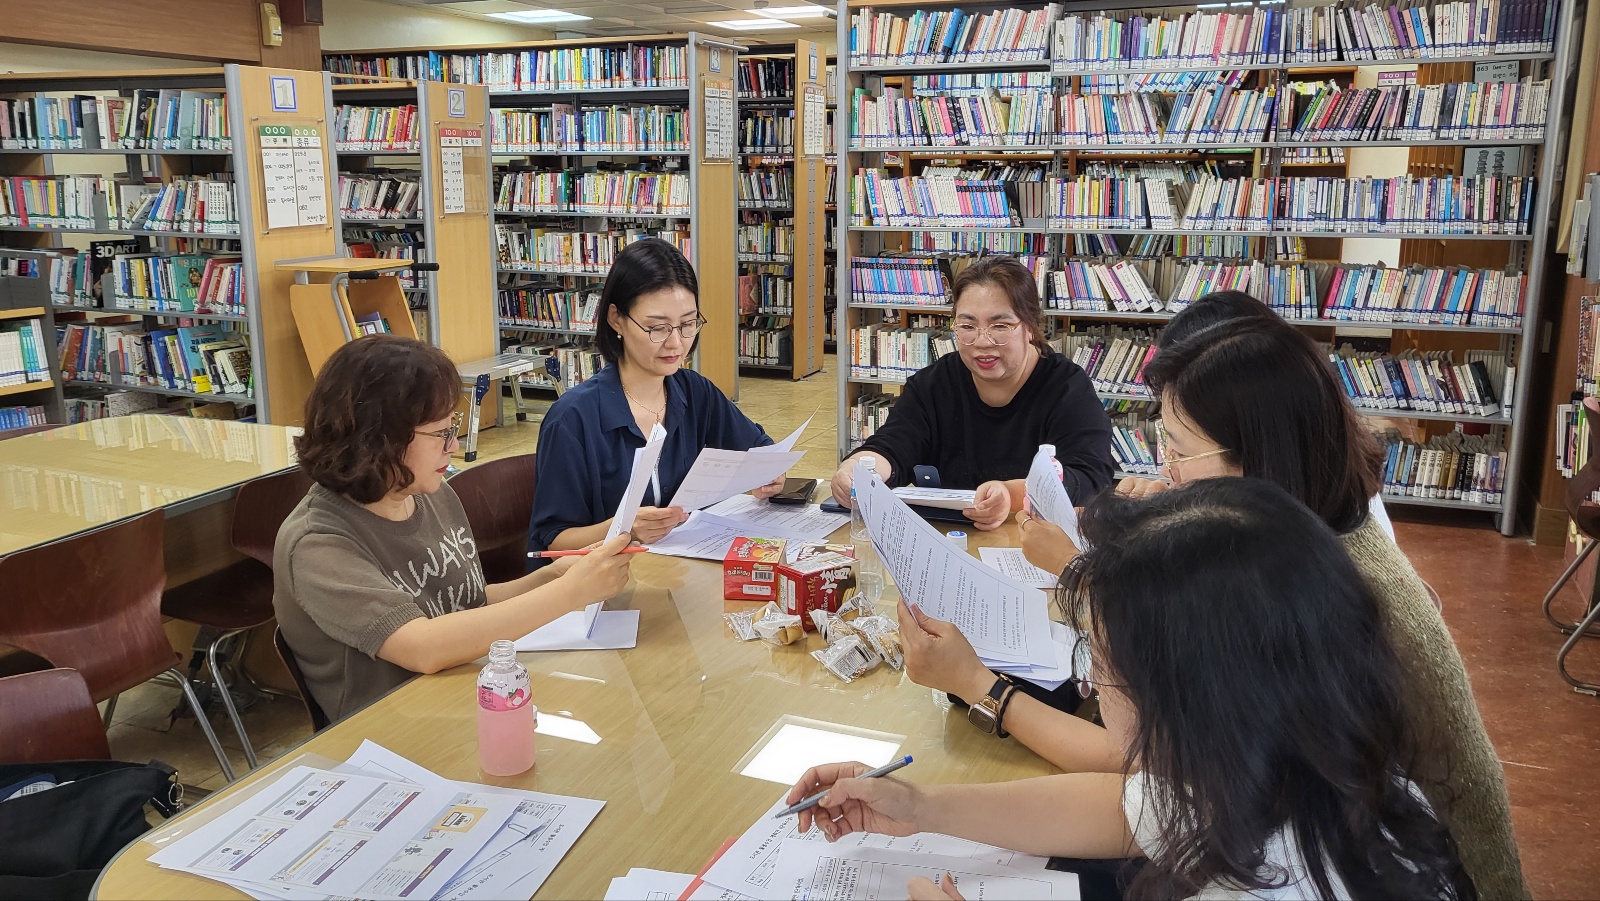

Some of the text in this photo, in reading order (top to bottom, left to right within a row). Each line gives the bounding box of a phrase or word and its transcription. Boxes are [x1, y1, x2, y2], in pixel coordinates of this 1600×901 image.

[711, 49, 720, 69] 3
[276, 82, 294, 106] 1
[451, 92, 463, 113] 2
[264, 126, 286, 134] 000
[294, 128, 317, 136] 000
